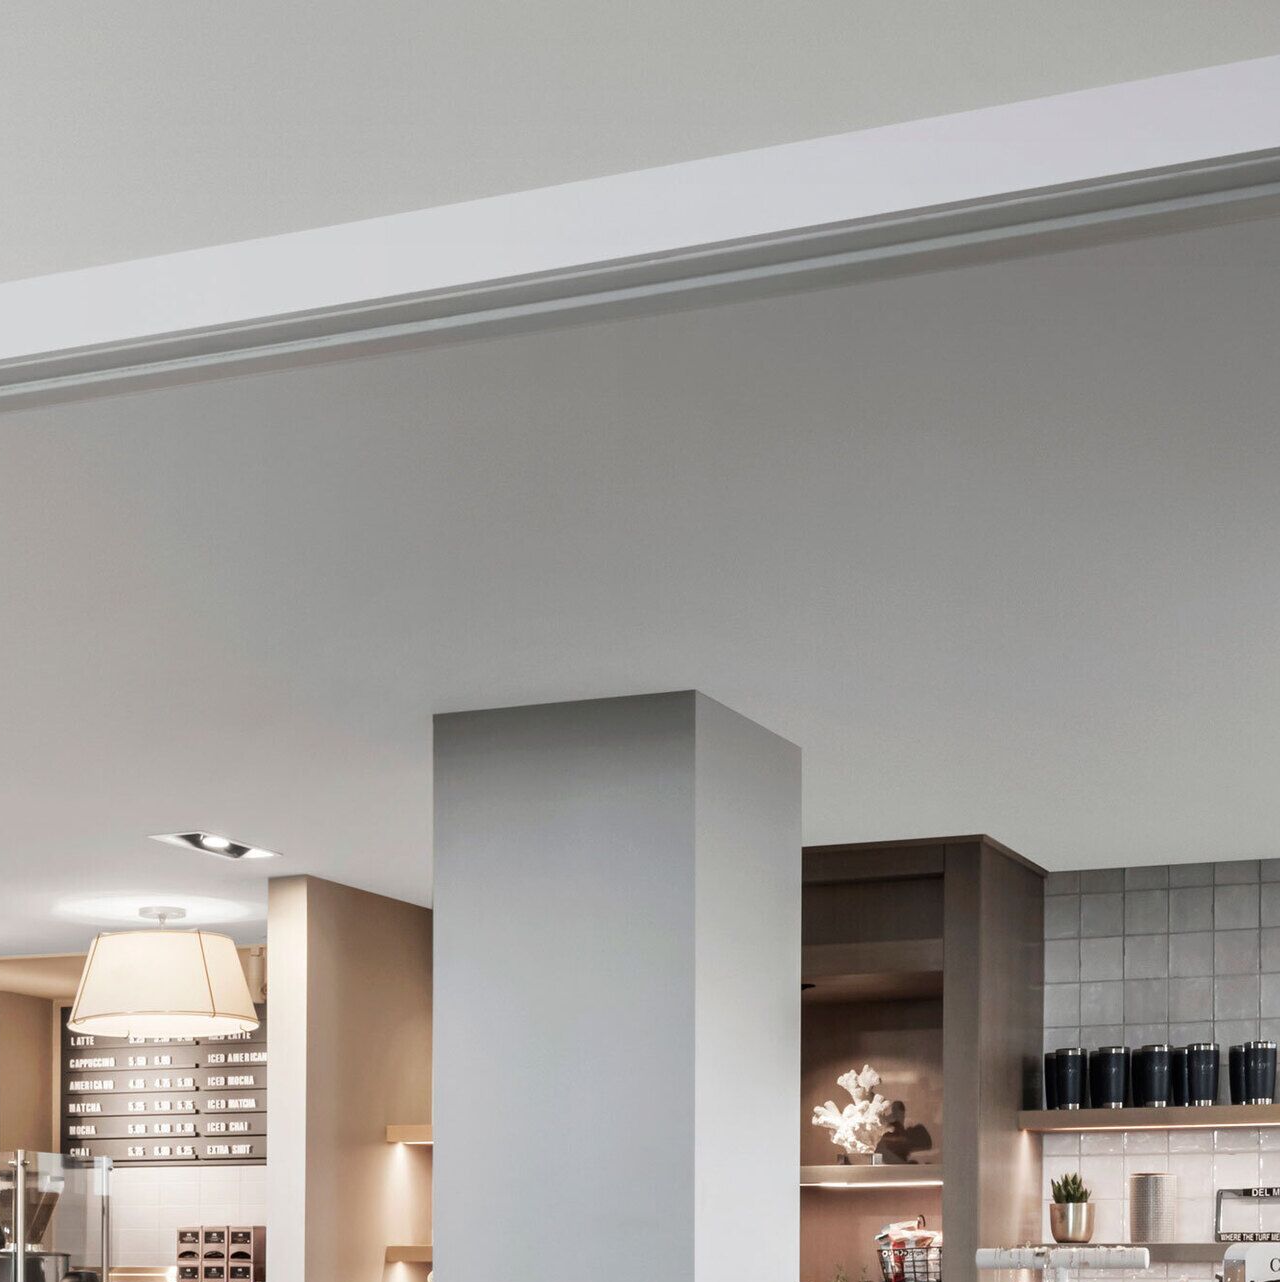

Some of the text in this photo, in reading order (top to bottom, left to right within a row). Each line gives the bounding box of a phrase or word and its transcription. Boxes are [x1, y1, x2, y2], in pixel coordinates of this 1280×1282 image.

[71, 1036, 94, 1046] LATTE
[70, 1057, 115, 1068] CAPPUCCINO
[208, 1053, 225, 1063] ICED
[69, 1080, 114, 1090] AMERICANO
[208, 1075, 254, 1086] ICED MOCHA
[69, 1103, 101, 1113] MATCHA
[207, 1098, 256, 1109] ICED MATCHA
[69, 1125, 96, 1135] MOCHA
[207, 1121, 248, 1132] ICED CHAI
[70, 1148, 89, 1158] CHAI
[207, 1144, 251, 1155] EXTRA SHOT
[1251, 1188, 1270, 1197] DEL
[1220, 1232, 1241, 1241] WHERE
[1242, 1232, 1254, 1241] THE
[1254, 1232, 1270, 1241] TURF
